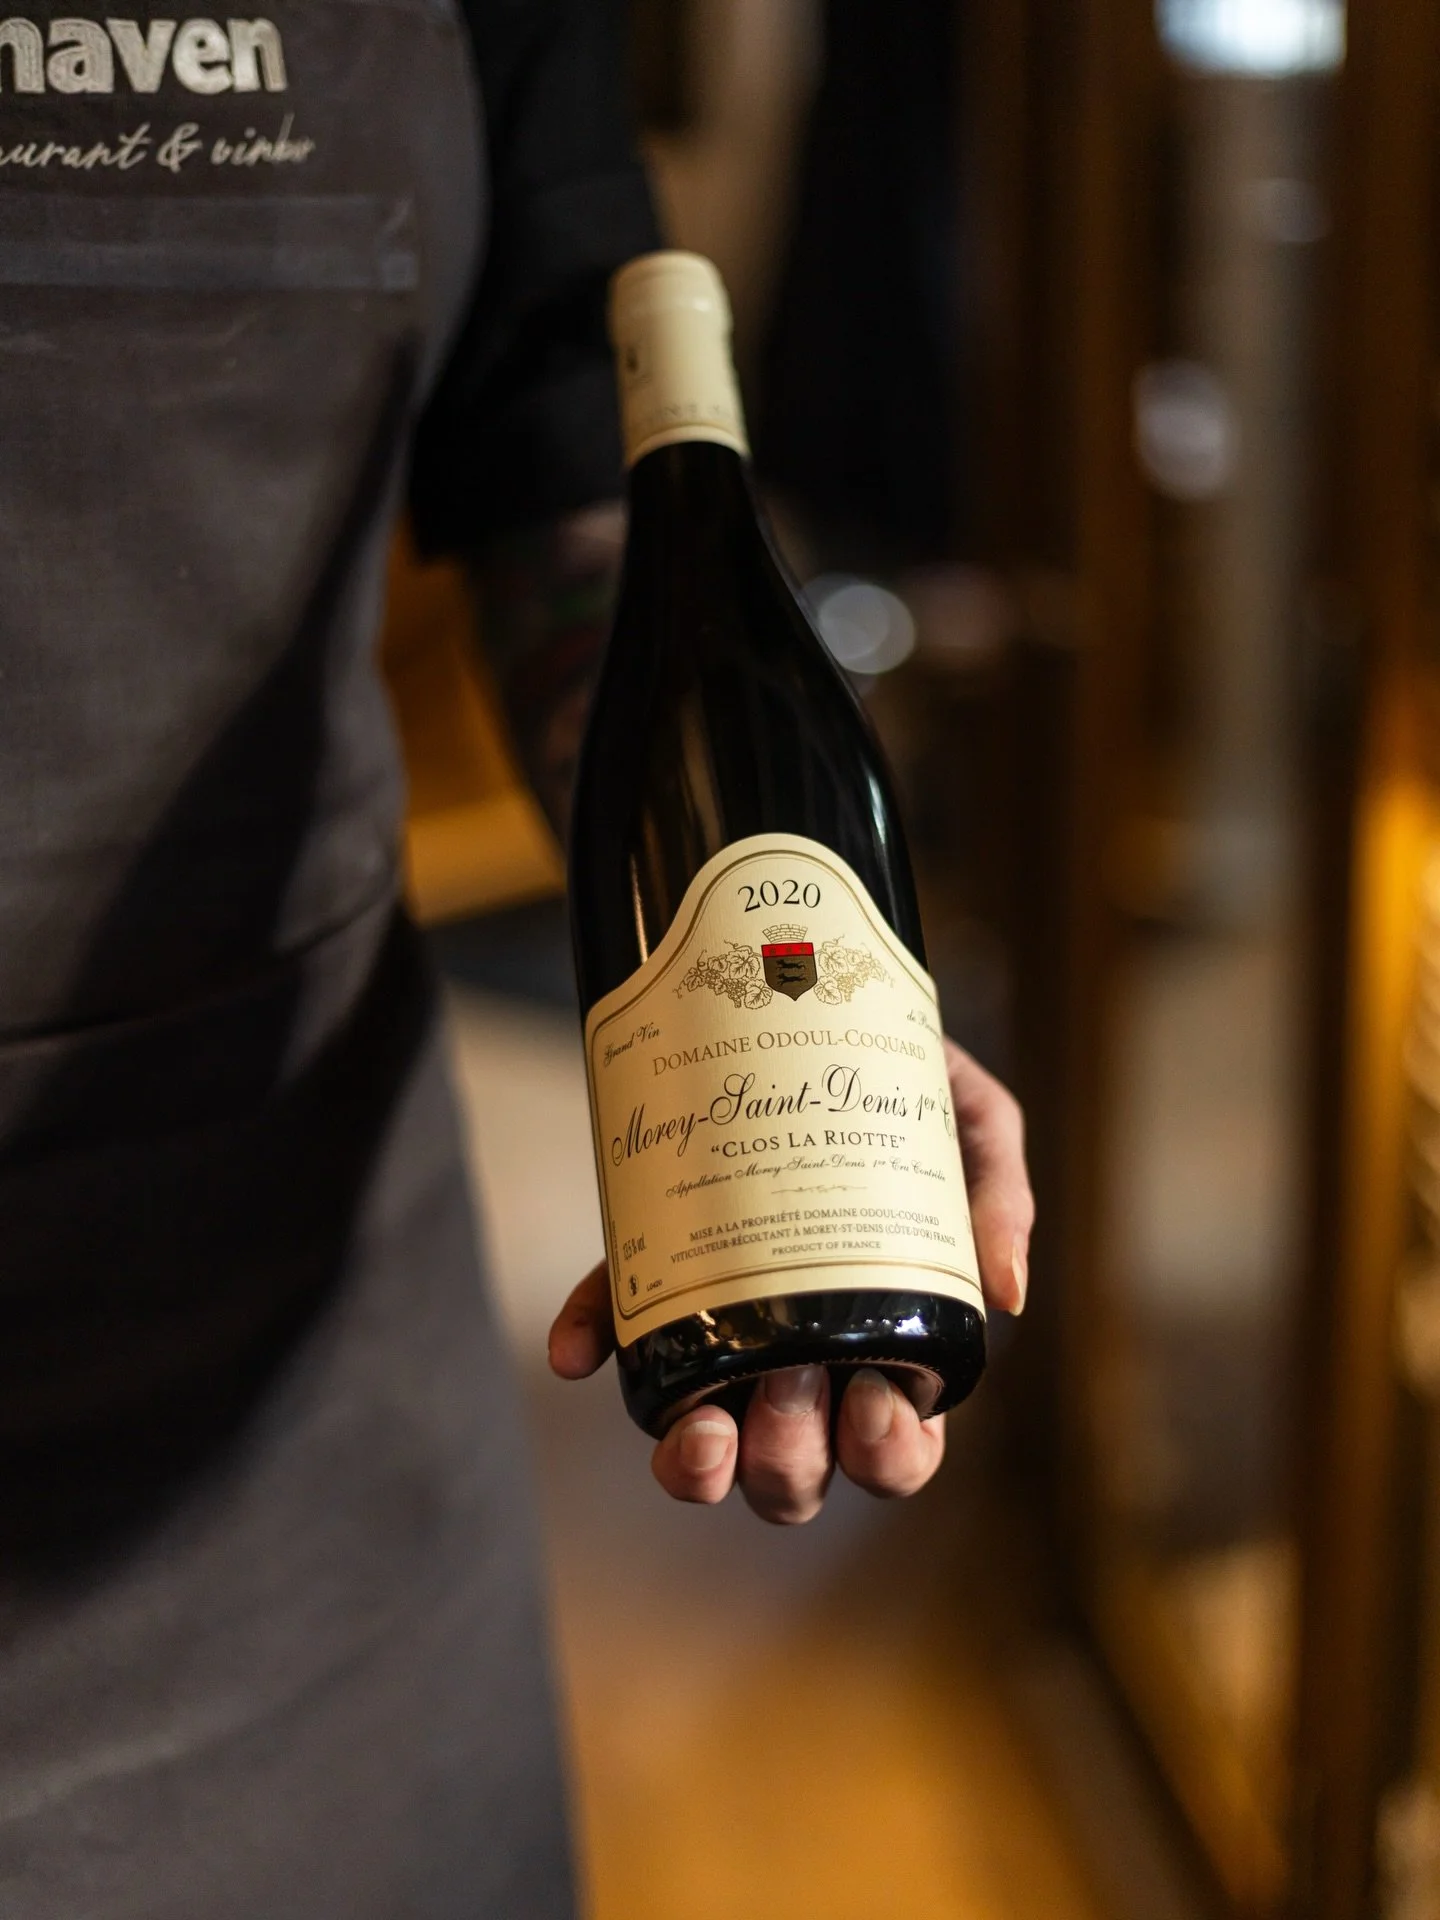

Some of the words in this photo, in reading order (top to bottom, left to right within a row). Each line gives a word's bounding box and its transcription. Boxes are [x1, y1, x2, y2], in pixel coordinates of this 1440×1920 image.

[0, 123, 152, 170] urant
[156, 122, 202, 173] &
[737, 879, 822, 913] 2020
[636, 1021, 661, 1042] Vin
[653, 1036, 752, 1077] DOMAINE
[756, 1028, 926, 1061] ODOUL-COQUARD
[612, 1064, 909, 1167] Morey-Saint-Denis
[788, 1132, 817, 1148] LA
[665, 1174, 732, 1198] Appellation
[734, 1154, 866, 1178] Morey-Saint-Denis
[670, 1228, 792, 1264] VITICULTEUR-RÉCOLTANT
[803, 1223, 884, 1236] MOREY-ST-DENIS
[933, 1231, 957, 1248] FRANCE
[690, 1226, 713, 1242] MISE
[725, 1221, 740, 1233] LA
[741, 1209, 801, 1230] PROPRIÉTÉ
[804, 1207, 858, 1220] DOMAINE
[860, 1207, 940, 1227] ODOUL-COQUARD
[772, 1241, 823, 1256] PRODUCT
[825, 1241, 840, 1251] OF
[842, 1240, 882, 1250] FRANCE
